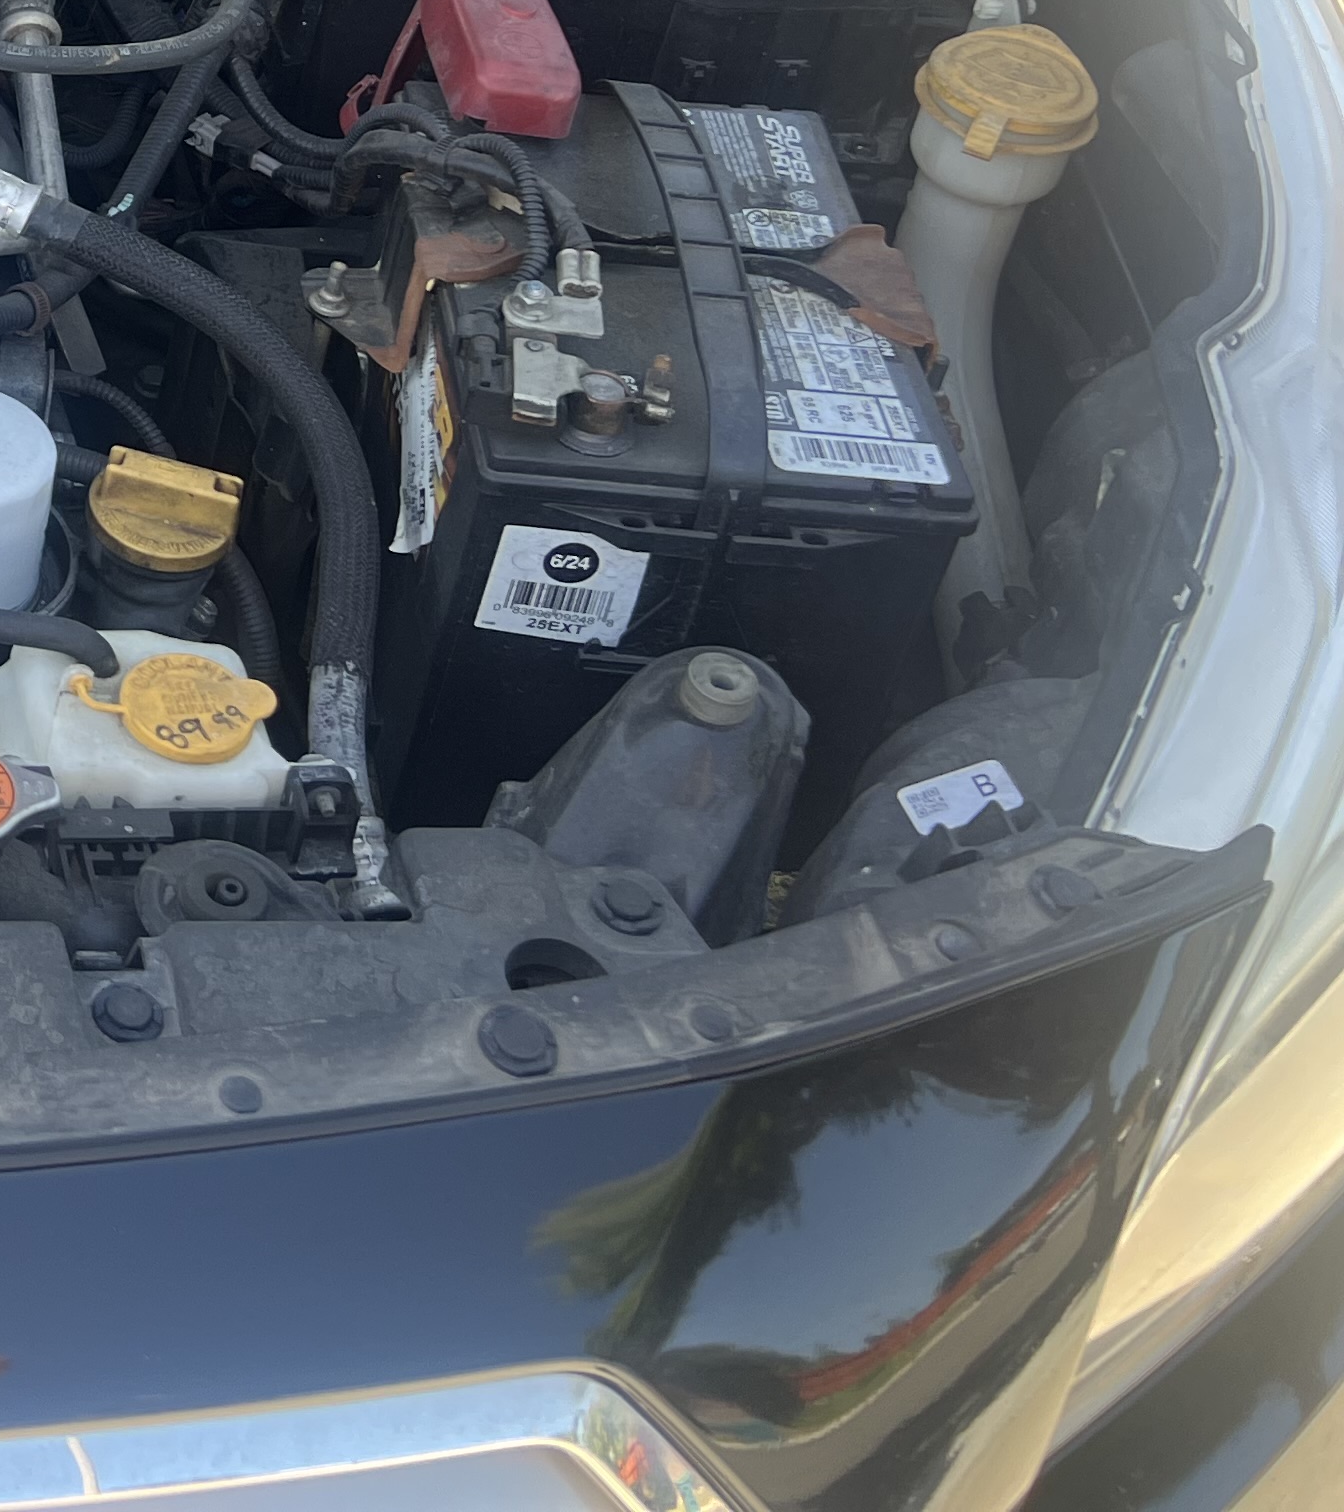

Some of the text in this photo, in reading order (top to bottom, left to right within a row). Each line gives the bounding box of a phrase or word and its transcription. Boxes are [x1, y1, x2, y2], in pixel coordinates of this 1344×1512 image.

[757, 114, 799, 187] START
[784, 125, 816, 185] SUPER
[836, 404, 856, 423] 625
[549, 553, 592, 571] 6/24
[526, 617, 587, 635] 25EXT
[970, 773, 998, 797] B
